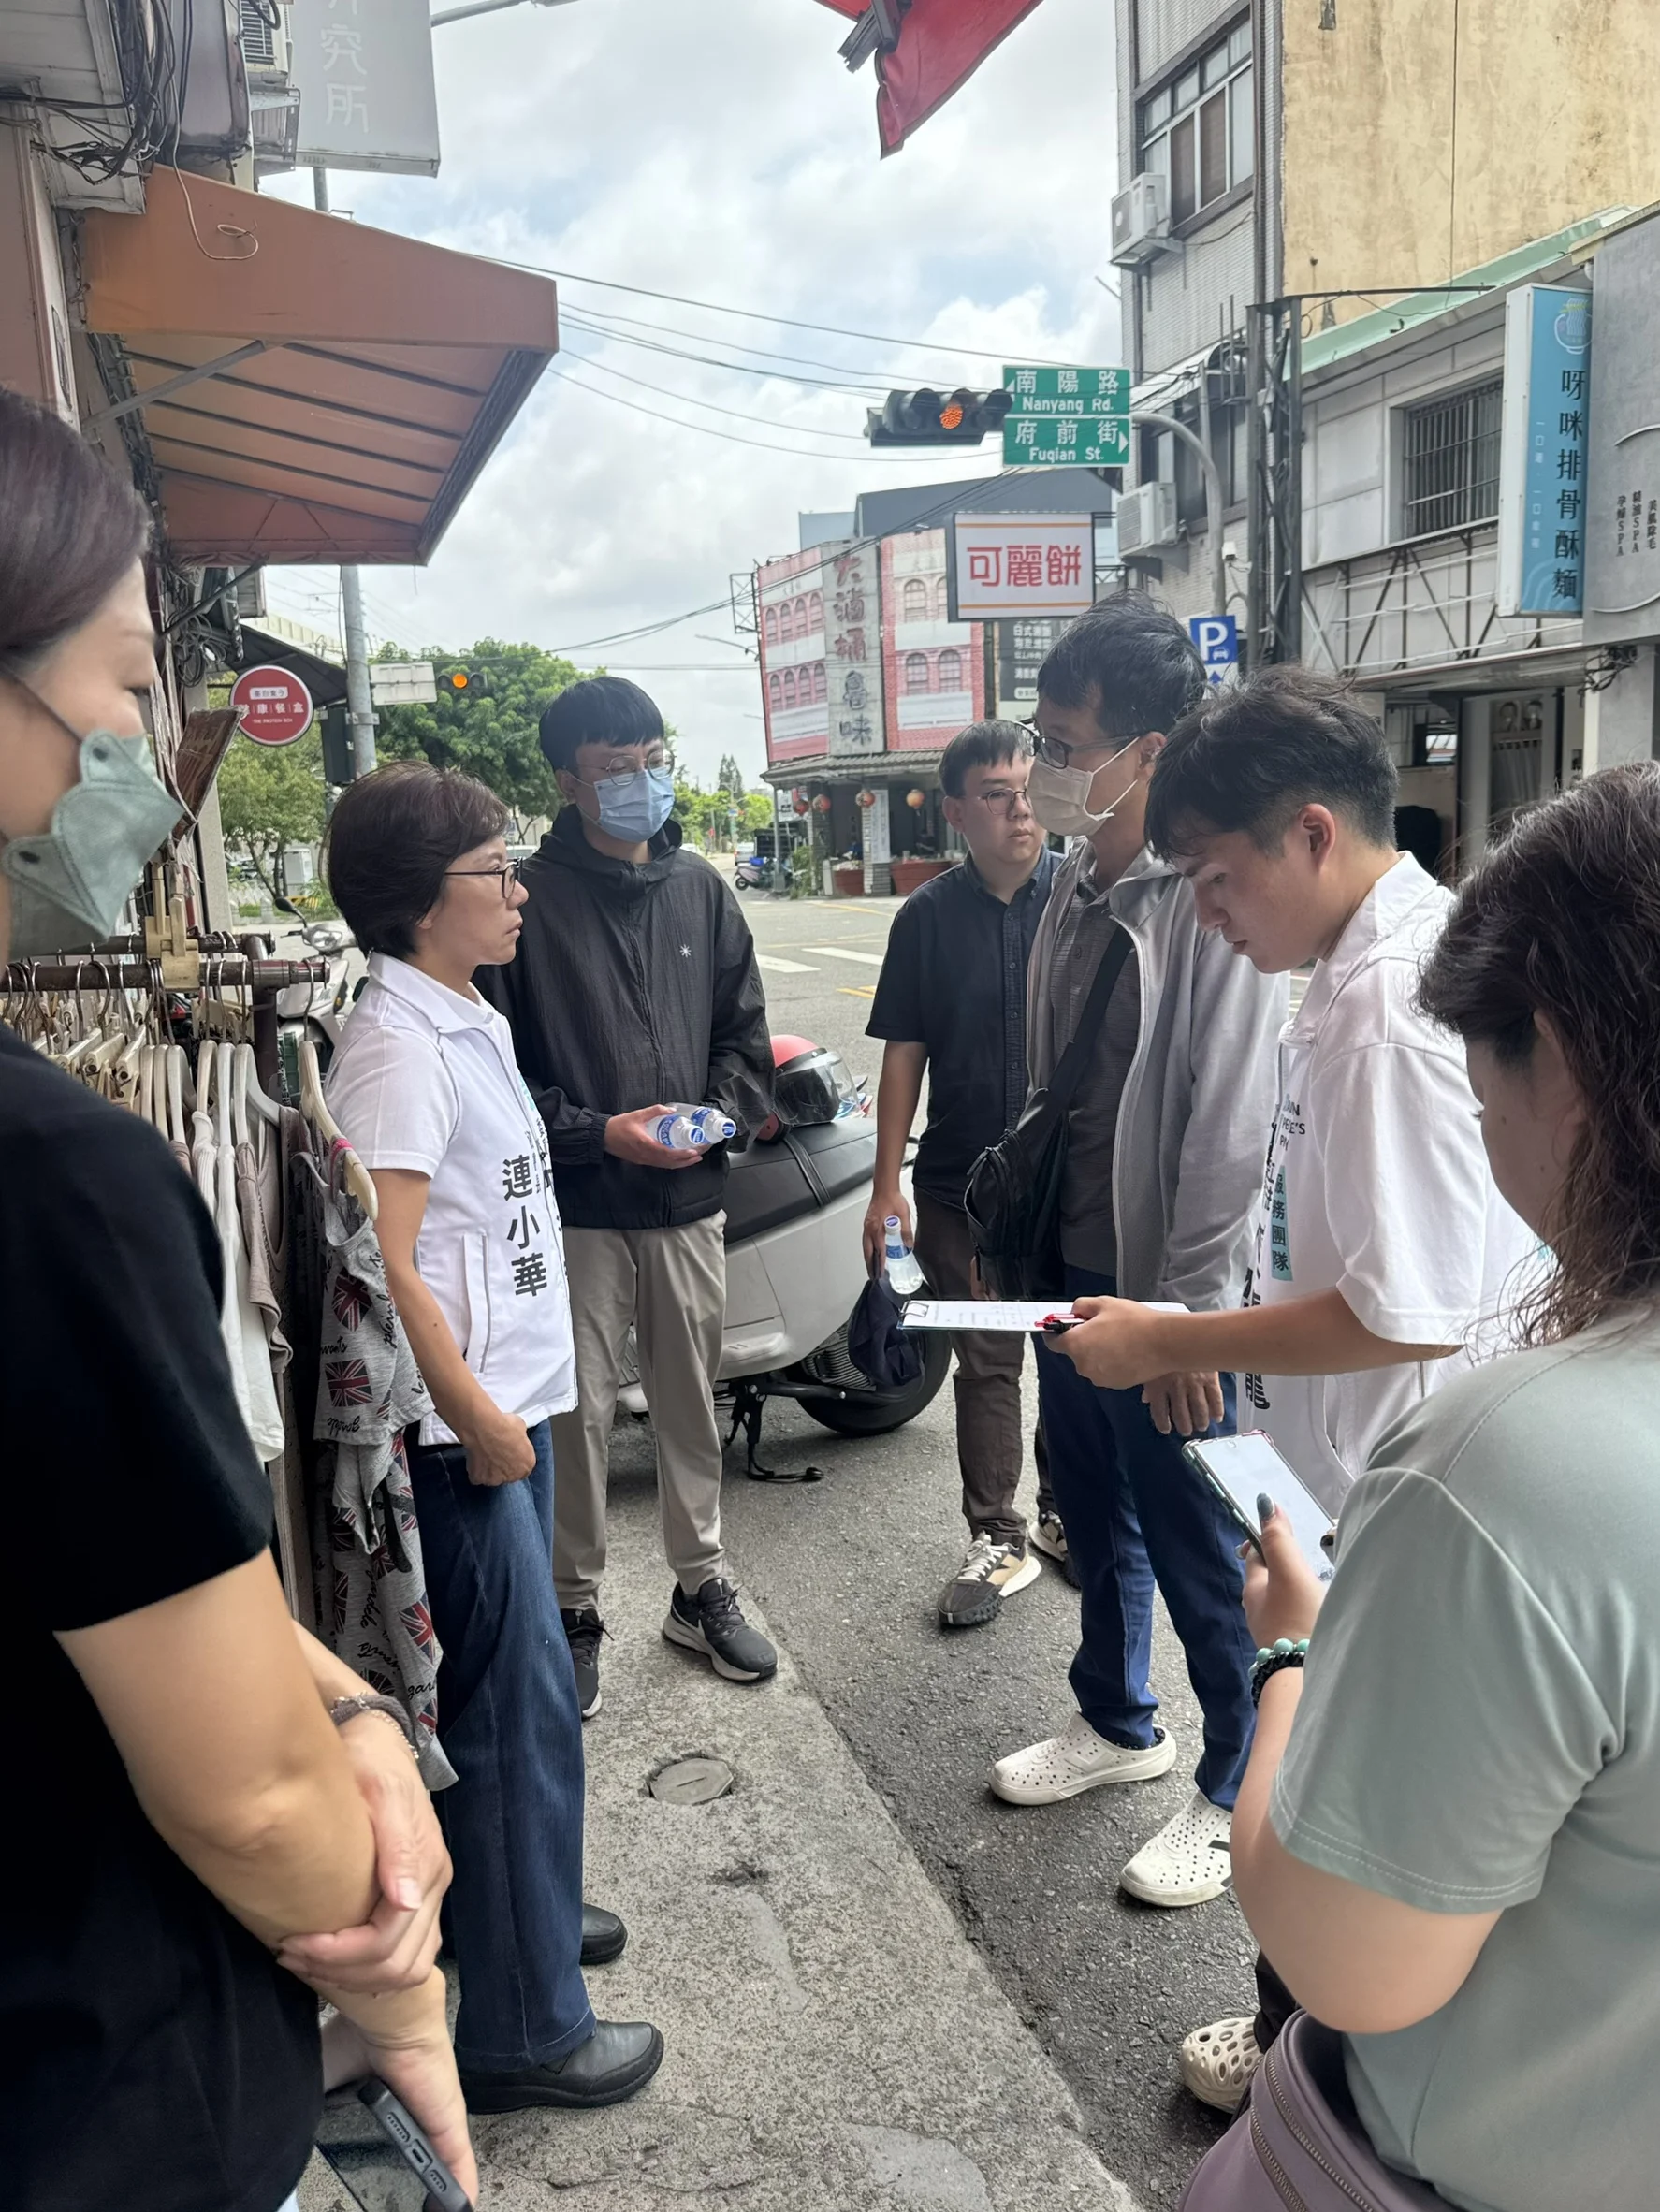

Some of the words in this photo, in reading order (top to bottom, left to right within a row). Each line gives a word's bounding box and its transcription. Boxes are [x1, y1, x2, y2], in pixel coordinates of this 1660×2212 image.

[321, 0, 368, 133] 究所
[1016, 370, 1119, 395] 南陽路
[1022, 397, 1084, 415] Nanyang
[1092, 398, 1114, 411] Rd.
[1015, 419, 1118, 444] 府前街
[1029, 447, 1076, 463] Fuqian
[1085, 447, 1104, 460] St.
[1552, 370, 1585, 599] 呀咪排骨酥麵
[967, 545, 1082, 587] 可麗餅
[1199, 621, 1228, 661] P
[502, 1154, 547, 1298] 連小華
